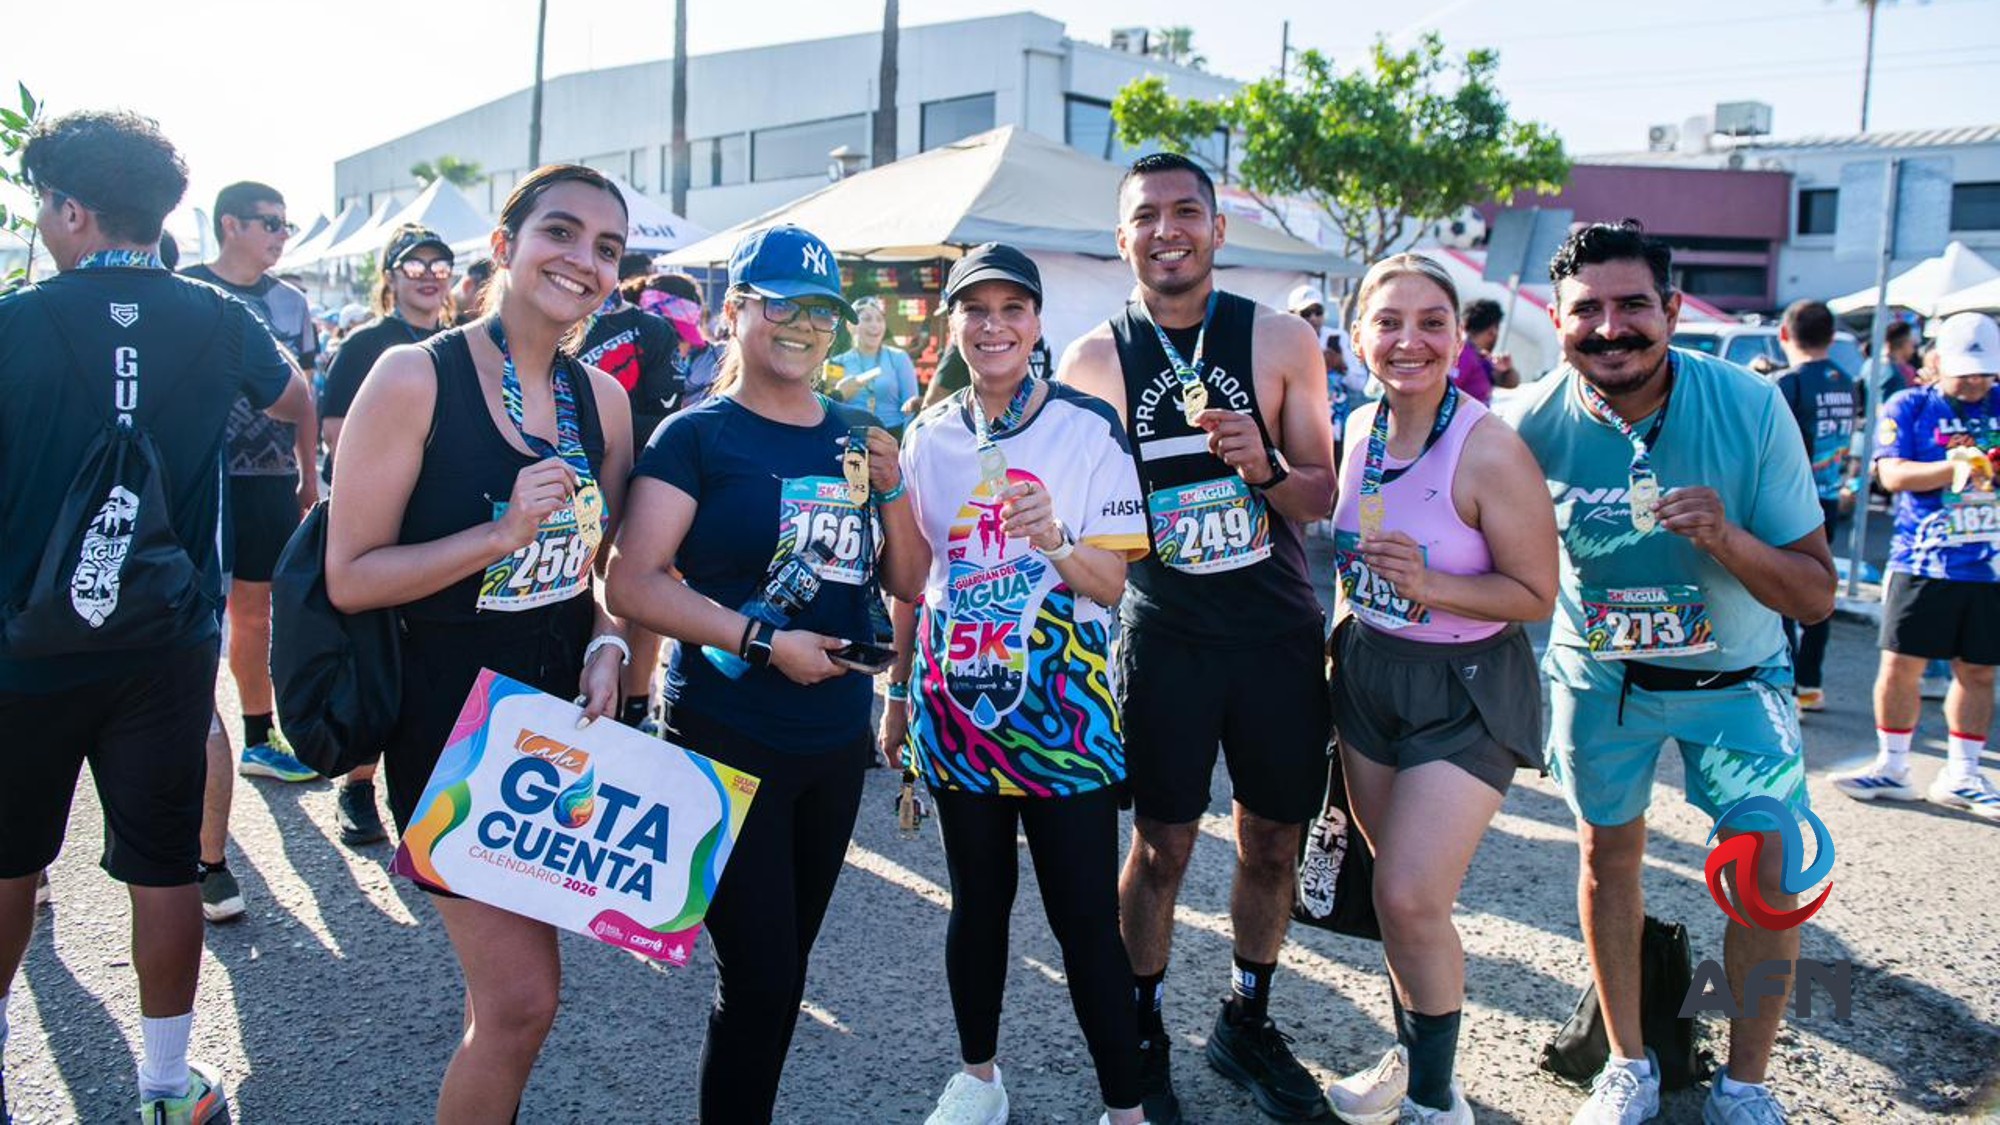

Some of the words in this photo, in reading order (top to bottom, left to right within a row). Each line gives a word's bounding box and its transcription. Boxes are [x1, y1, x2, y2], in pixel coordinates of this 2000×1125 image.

[1136, 368, 1178, 438] PROJE
[790, 512, 862, 560] 166
[1176, 508, 1252, 558] 249
[74, 568, 118, 591] 5K
[508, 536, 588, 588] 258
[954, 573, 1031, 615] AGUA
[948, 622, 1016, 661] 5K
[1605, 612, 1685, 647] 273
[500, 757, 669, 864] GOTA
[468, 844, 562, 886] CALENDARIO
[562, 876, 597, 898] 2026
[477, 810, 653, 902] CUENTA
